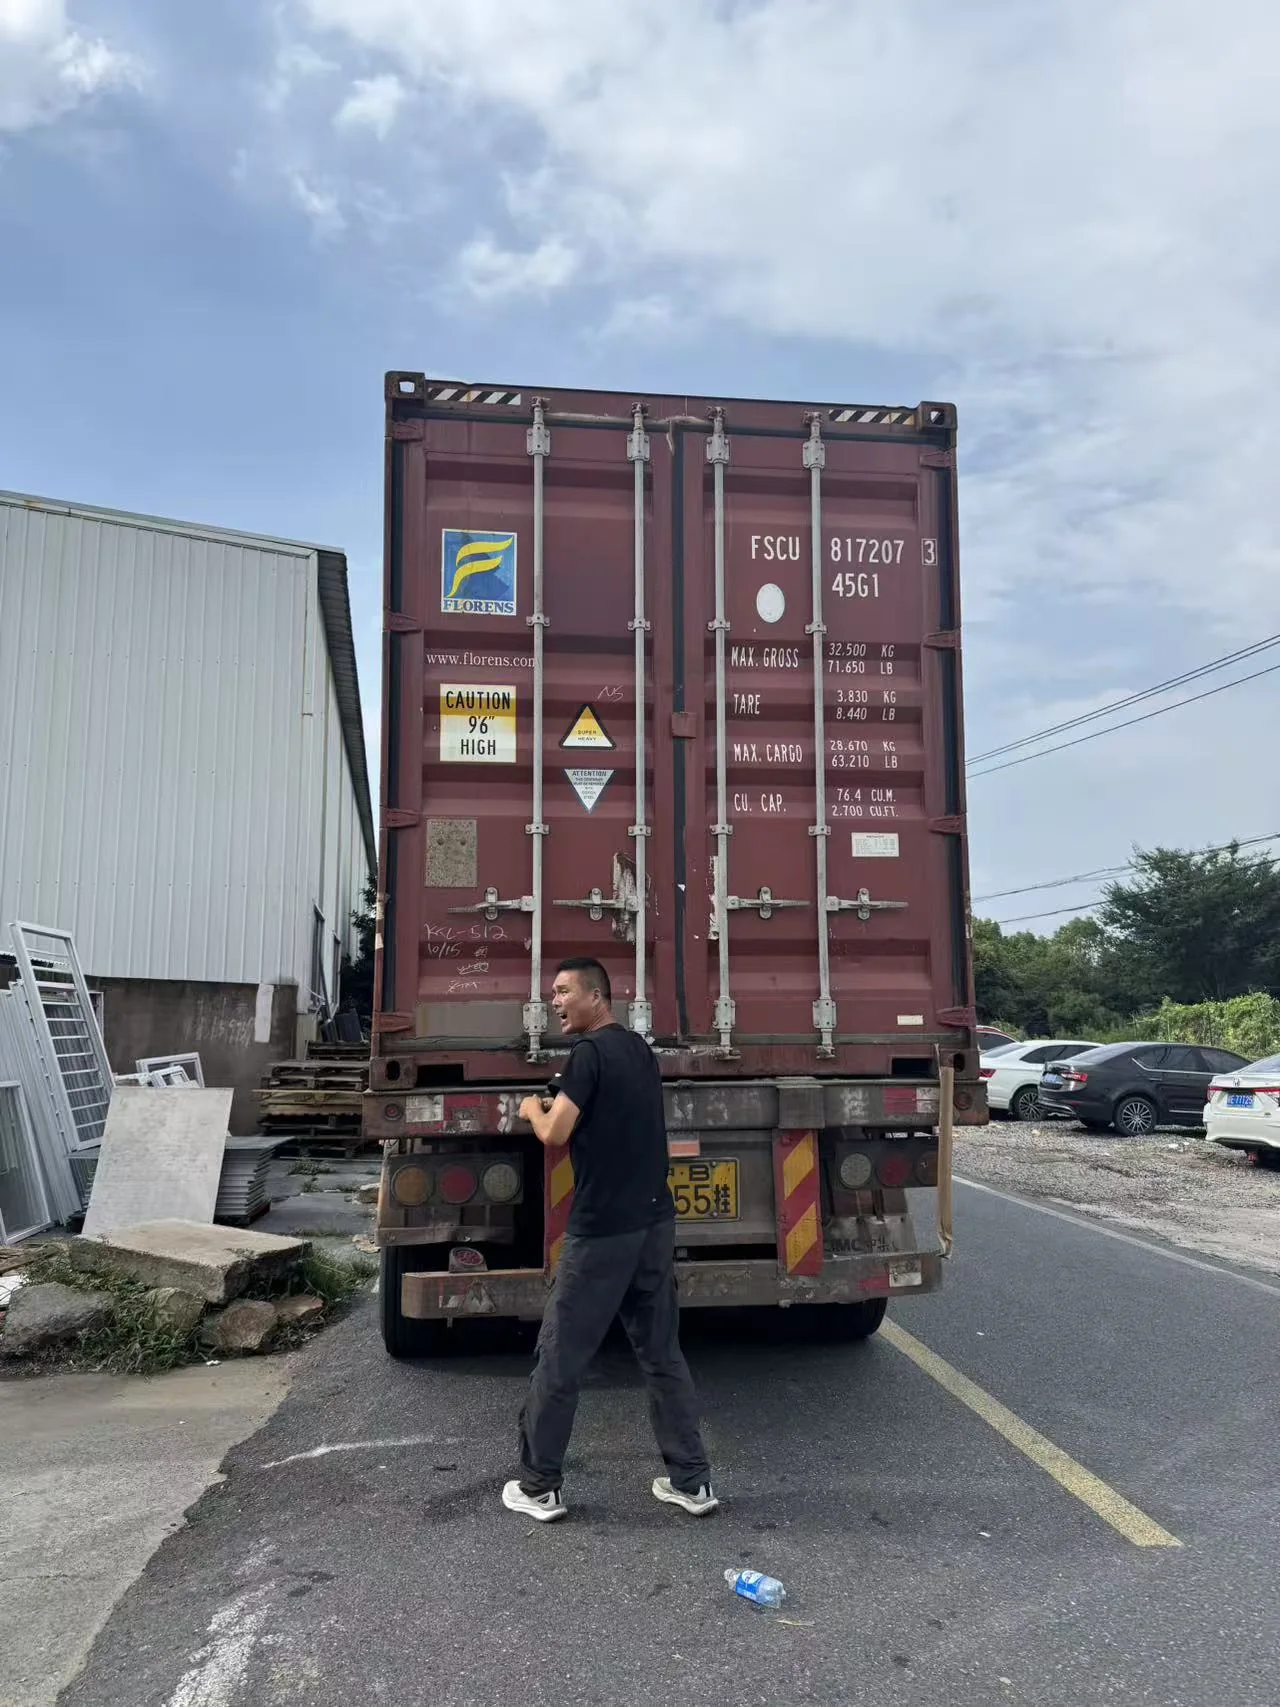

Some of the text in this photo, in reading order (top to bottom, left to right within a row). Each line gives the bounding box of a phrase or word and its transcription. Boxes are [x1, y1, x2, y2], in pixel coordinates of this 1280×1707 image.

[751, 535, 935, 564] FSCU 817207 3
[831, 573, 879, 597] 45G1
[443, 600, 514, 613] FLORENS
[731, 646, 759, 667] MAX.
[763, 647, 799, 668] GROSS
[881, 644, 895, 658] KG
[880, 661, 893, 675] LB
[446, 690, 510, 710] CAUTION
[733, 693, 761, 715] TARE
[883, 690, 896, 704] KG
[882, 707, 896, 721] LB
[460, 738, 496, 756] HIGH
[733, 743, 762, 763] MAX.
[766, 743, 803, 763] CARGO
[882, 741, 896, 752] KG
[885, 755, 898, 769] LB
[734, 793, 752, 812] CU.
[761, 793, 786, 812] CAP.
[837, 788, 861, 802] 76.4
[831, 804, 863, 817] 2.700
